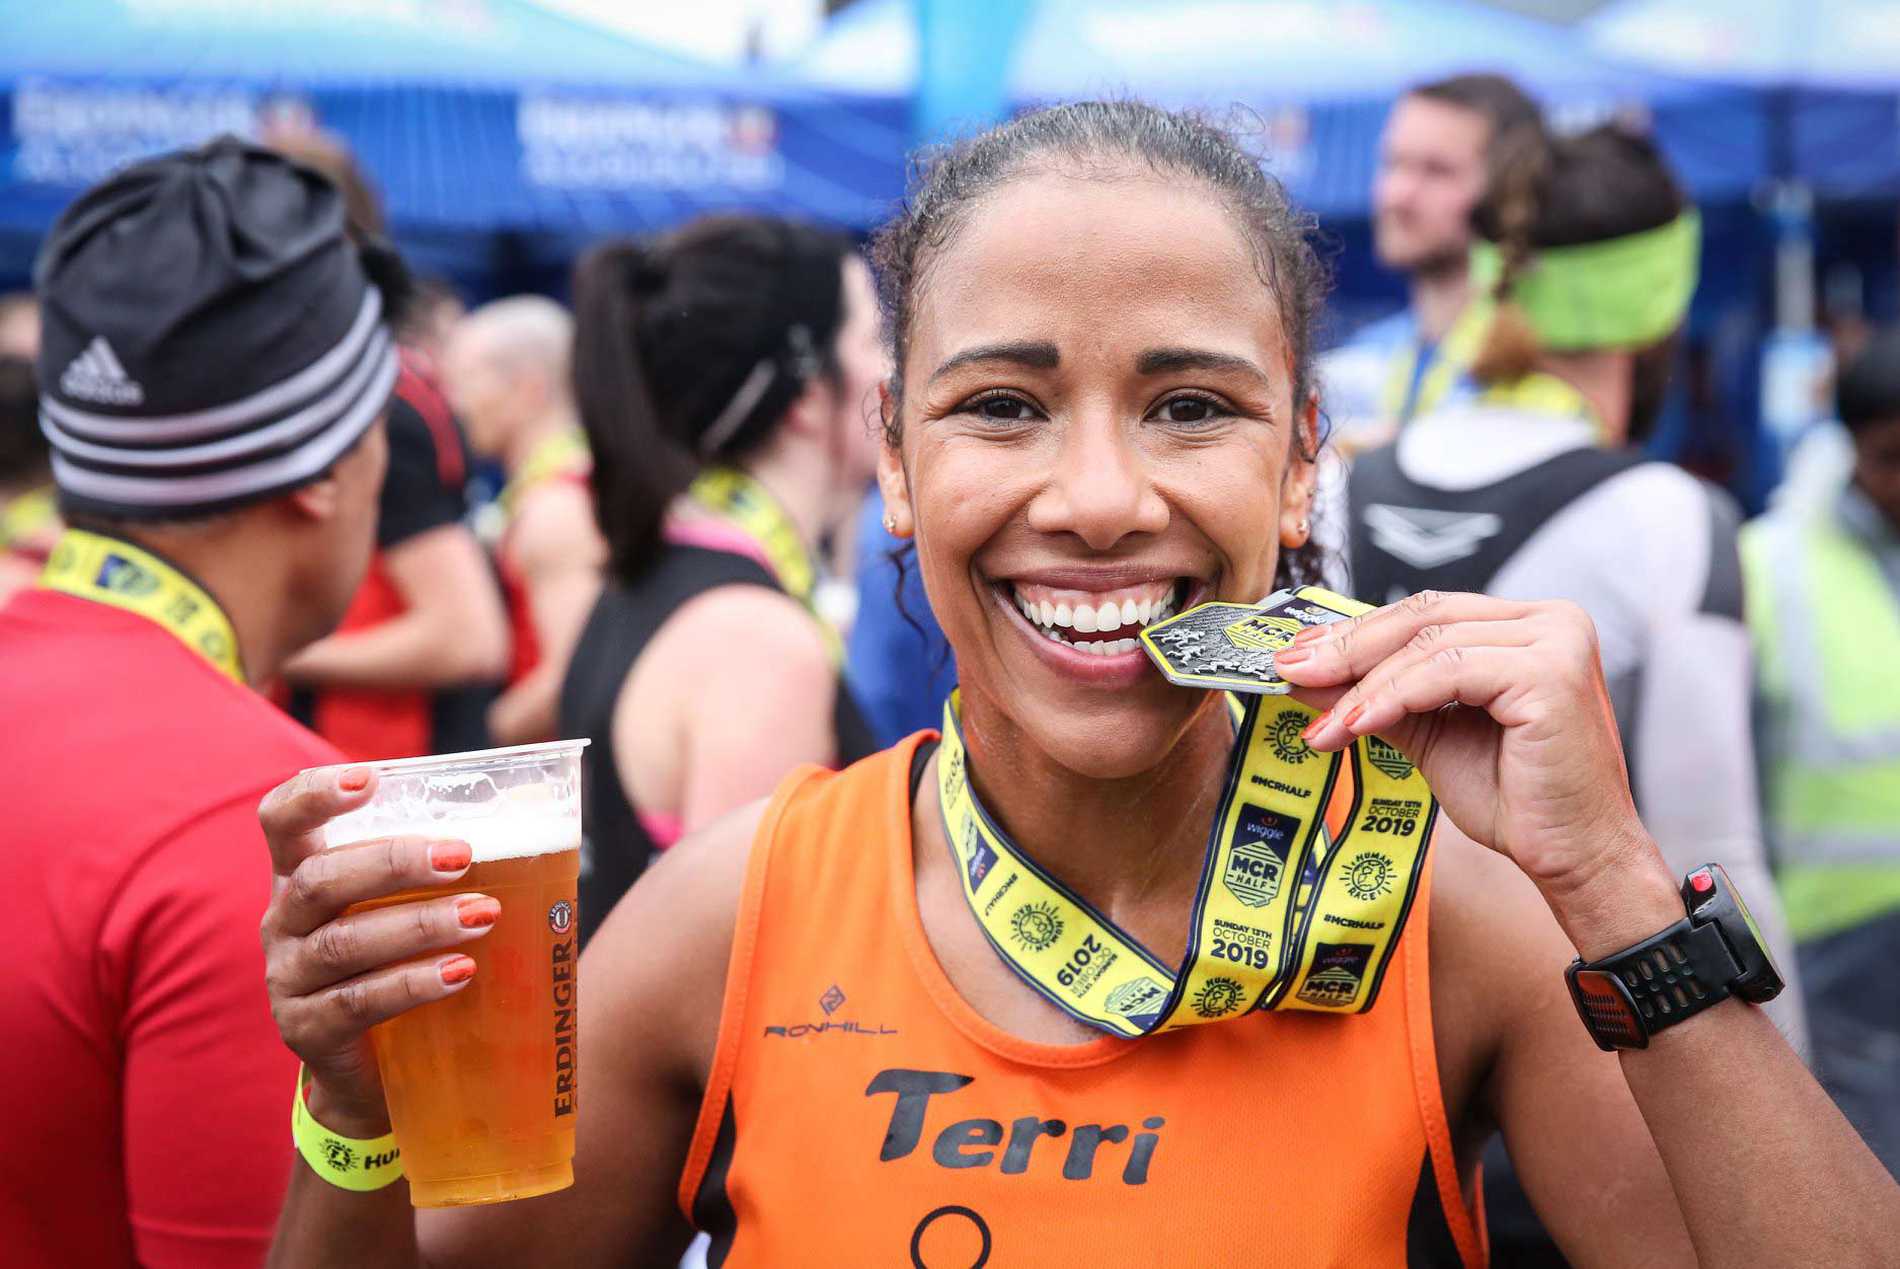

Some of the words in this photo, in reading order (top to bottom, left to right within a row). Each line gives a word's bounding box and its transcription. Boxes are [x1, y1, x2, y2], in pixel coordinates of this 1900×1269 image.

[1277, 710, 1310, 727] HUMA
[1251, 775, 1312, 798] #MCRHALF
[1369, 806, 1420, 818] OCTOBER
[1361, 815, 1416, 836] 2019
[1356, 852, 1392, 866] HUMAN
[1231, 855, 1278, 881] MCR
[1236, 876, 1267, 889] HALF
[1347, 888, 1377, 901] RACE
[1214, 919, 1250, 934] SUNDAY
[1324, 914, 1385, 930] #MCRHALF
[1213, 927, 1271, 950] OCTOBER
[1057, 933, 1102, 986] 2019
[1210, 939, 1269, 970] 2019
[1305, 980, 1355, 994] MCR
[553, 936, 572, 1119] ERDINGER
[764, 1021, 897, 1038] RONHILL
[865, 1068, 1165, 1185] Terri
